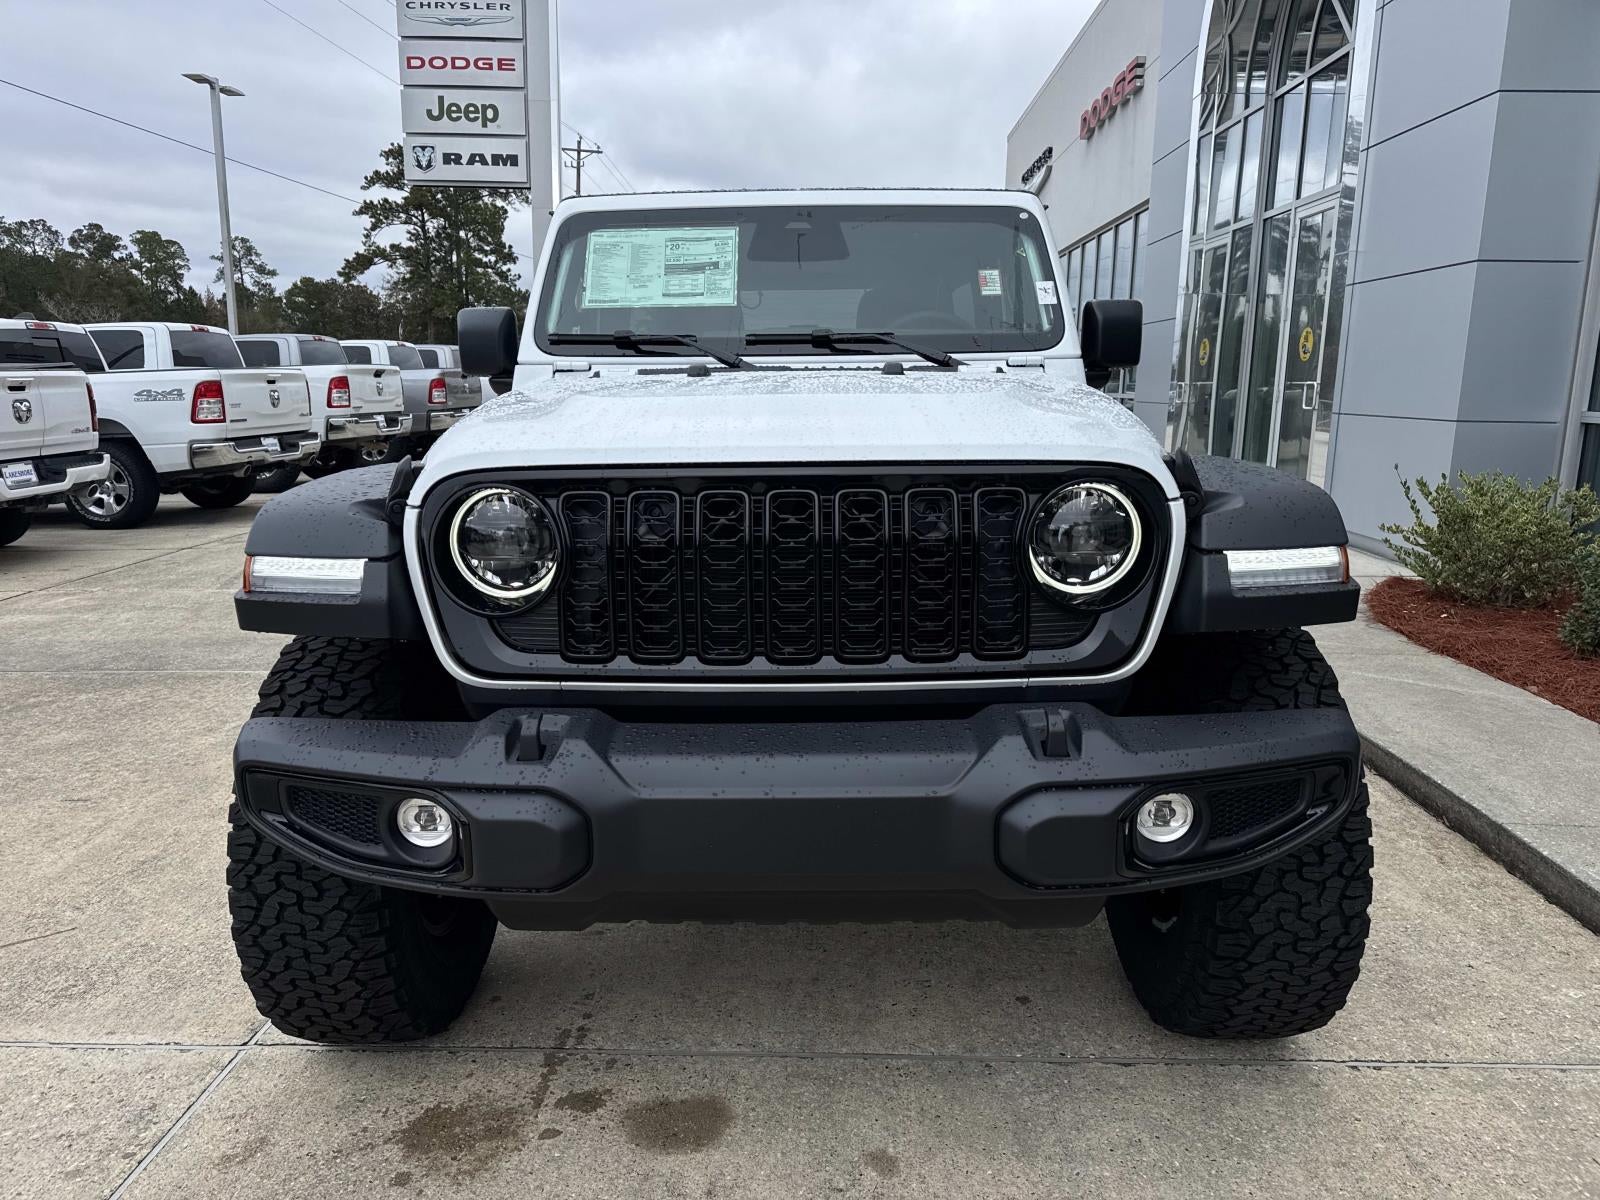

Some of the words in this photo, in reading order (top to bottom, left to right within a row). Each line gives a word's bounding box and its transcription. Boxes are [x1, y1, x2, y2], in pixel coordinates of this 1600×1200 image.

[405, 1, 511, 11] CHRYSLER
[406, 56, 516, 72] DODGE
[1079, 55, 1147, 140] DODGE
[425, 95, 500, 129] Jeep
[442, 152, 519, 167] RAM
[669, 243, 680, 251] 20
